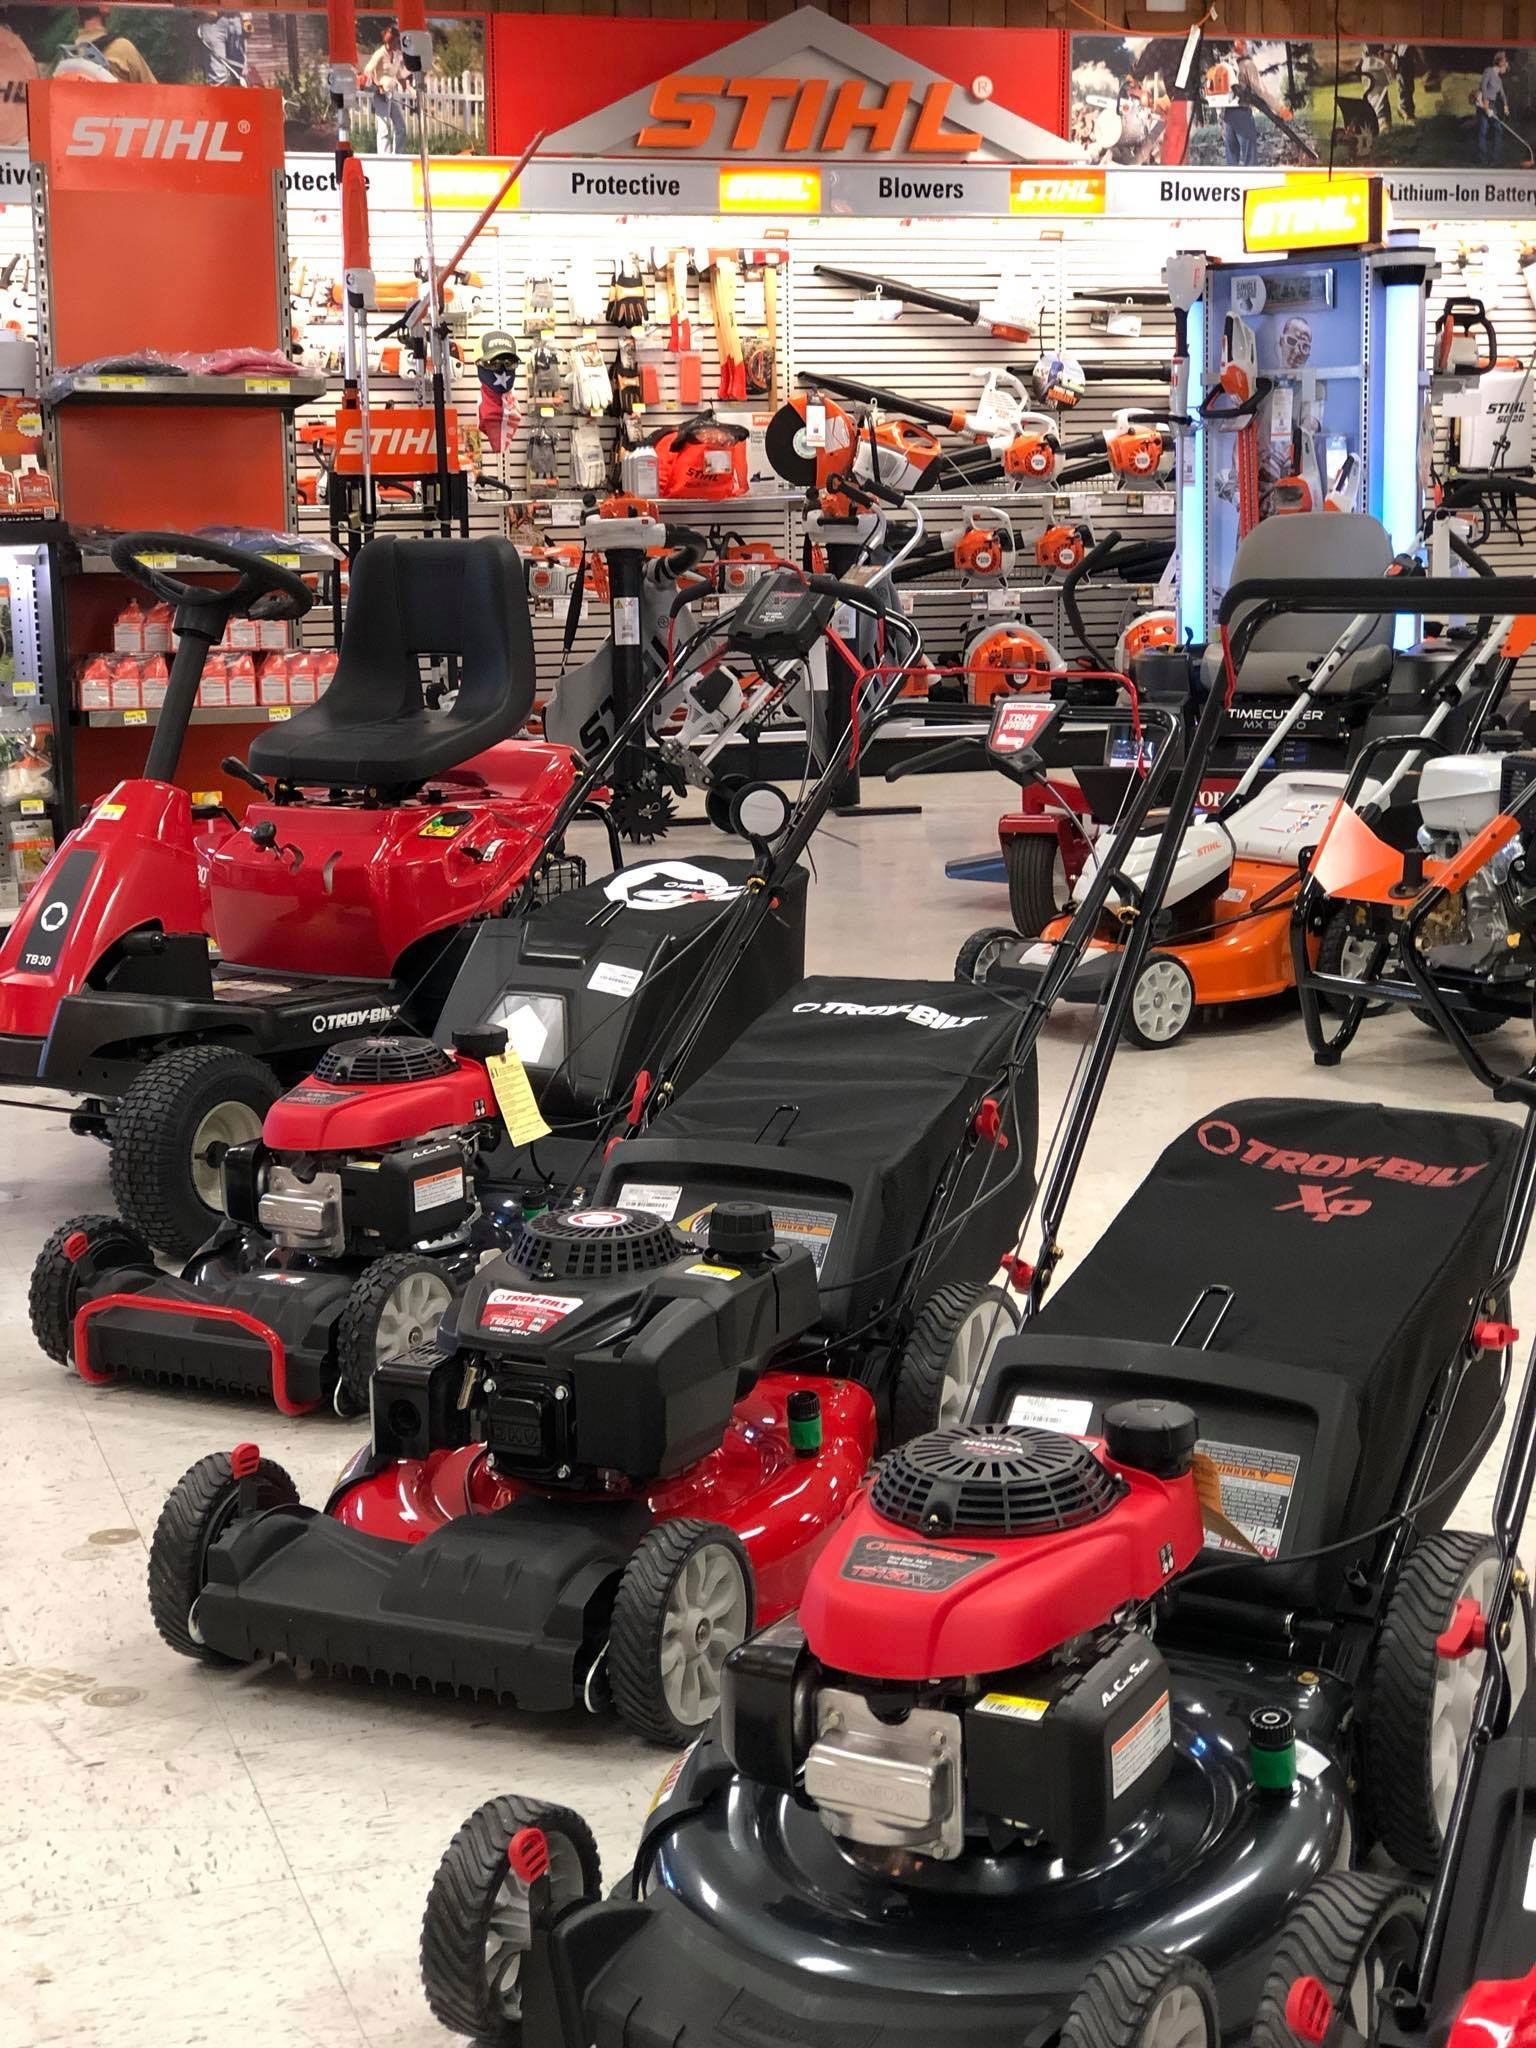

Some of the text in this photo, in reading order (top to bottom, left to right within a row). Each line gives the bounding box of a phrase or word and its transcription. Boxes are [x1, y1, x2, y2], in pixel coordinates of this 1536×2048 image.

[637, 76, 983, 152] STIHL
[66, 117, 244, 162] STIHL
[571, 172, 680, 197] Protective
[879, 177, 964, 200] Blowers
[1017, 179, 1096, 201] STIHL
[1160, 181, 1241, 202] Blowers
[1389, 184, 1480, 202] Lithium-Ion
[1250, 196, 1356, 238] STIHL
[1486, 401, 1526, 415] STIHL
[686, 466, 719, 482] STIHL
[1243, 721, 1307, 730] MX 50
[1196, 842, 1222, 857] STIHL
[25, 954, 51, 966] TB30
[327, 1004, 401, 1030] TROY-BILT
[819, 1002, 985, 1030] TROY-BILT
[1240, 1138, 1489, 1188] TROY-BILT
[504, 1294, 571, 1309] TROY-BILT
[489, 1317, 525, 1328] TB220
